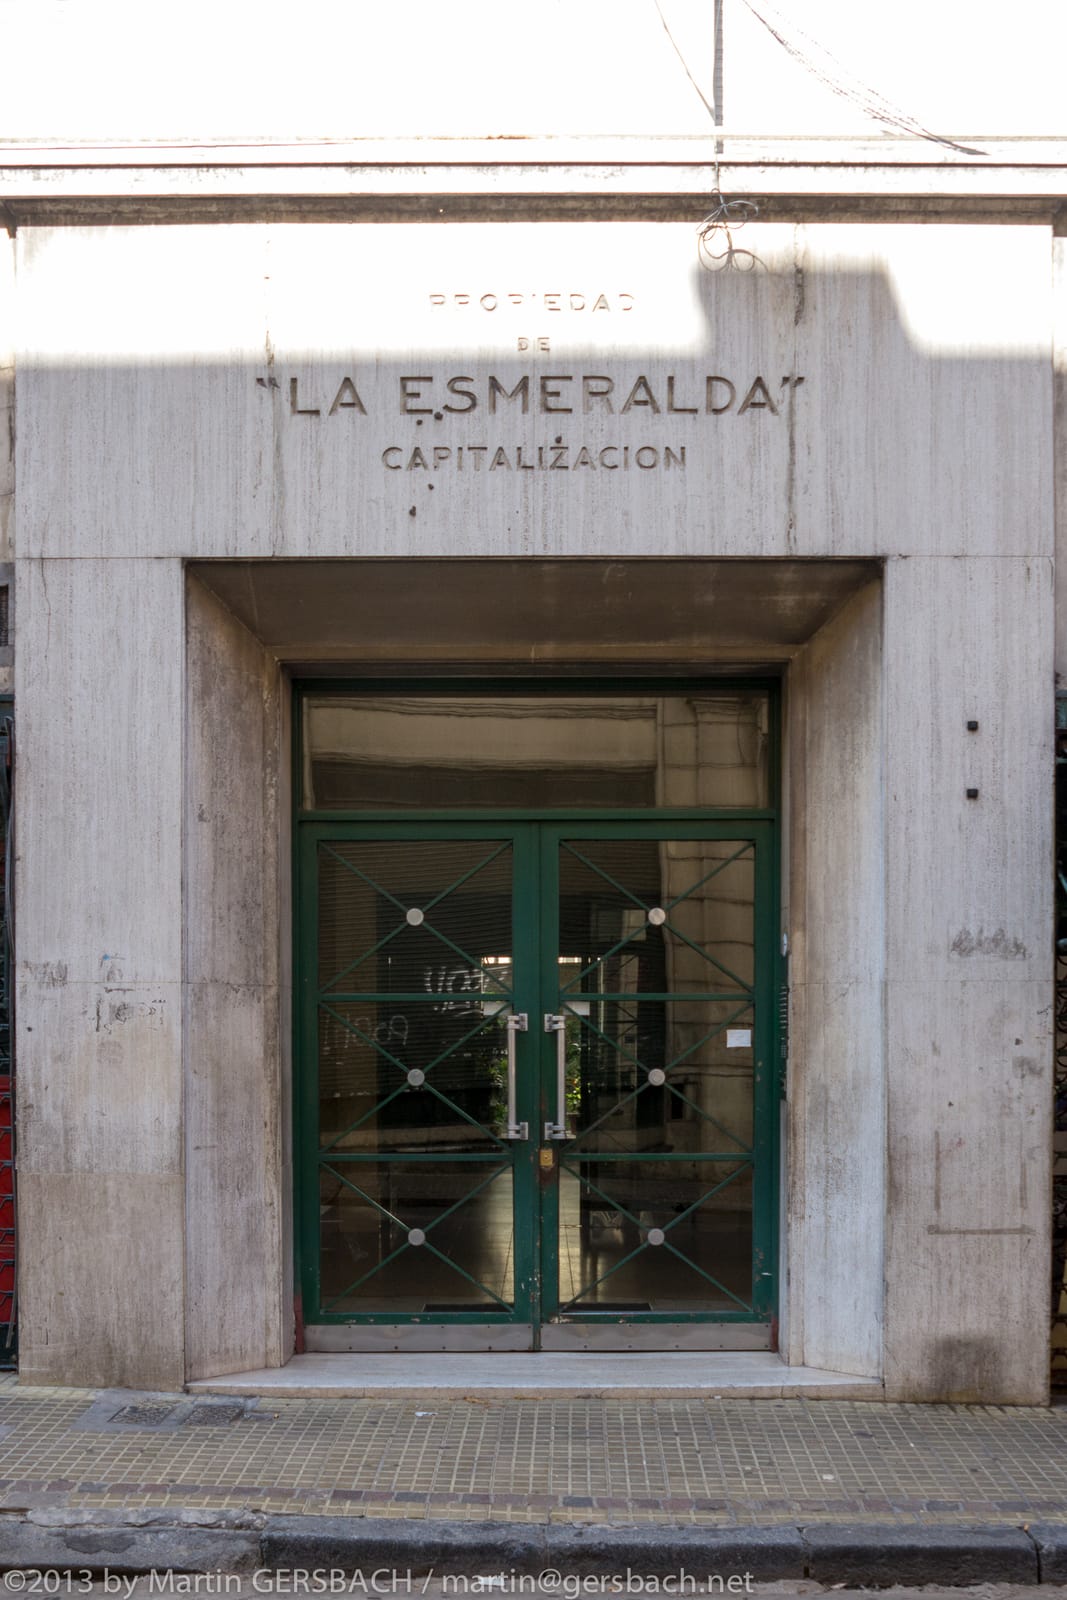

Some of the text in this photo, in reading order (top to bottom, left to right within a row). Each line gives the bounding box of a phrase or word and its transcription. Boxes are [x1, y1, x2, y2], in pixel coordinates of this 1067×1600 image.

[429, 293, 635, 312] POPEDAD
[517, 336, 550, 352] DE
[381, 446, 686, 471] CAPITALIZACION
